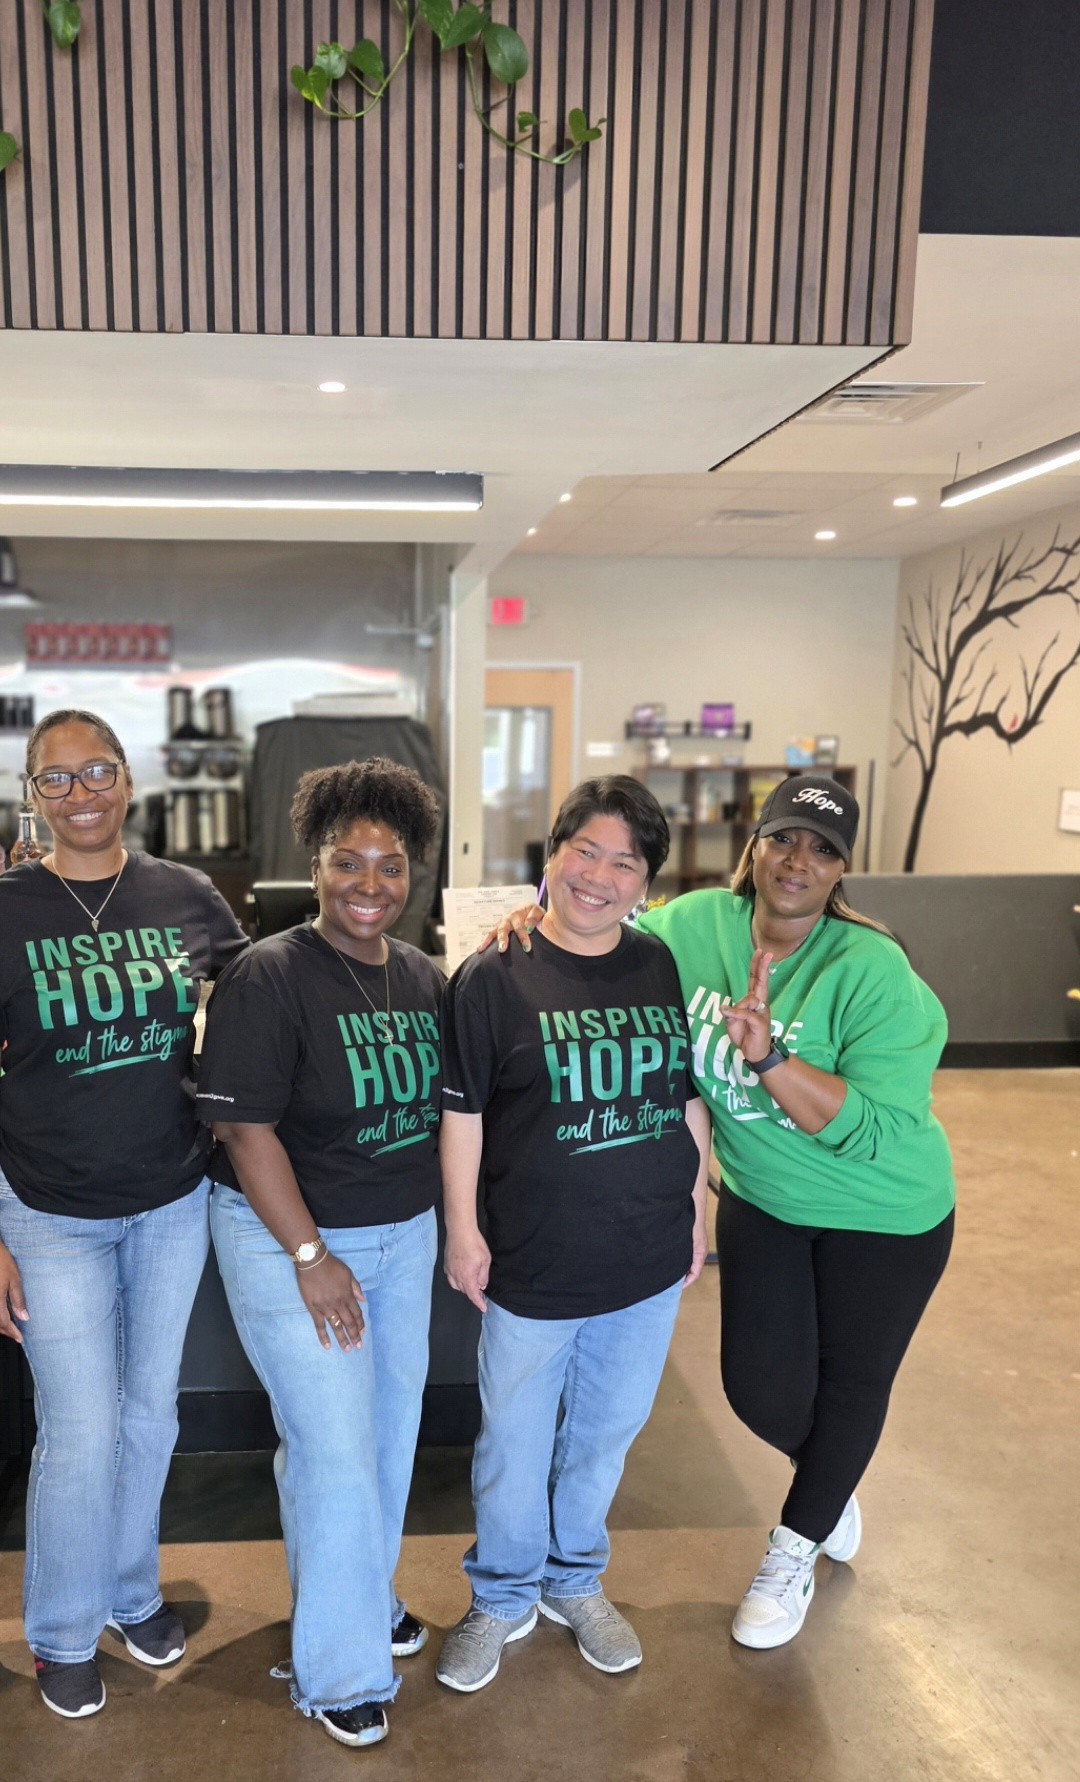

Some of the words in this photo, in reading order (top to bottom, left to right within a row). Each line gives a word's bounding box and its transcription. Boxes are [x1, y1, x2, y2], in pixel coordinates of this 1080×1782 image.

[792, 788, 843, 815] Hope
[25, 927, 189, 971] INSPIRE
[33, 958, 197, 1030] HOPE
[336, 1011, 439, 1046] INSPIR
[538, 1006, 687, 1042] INSPIRE
[56, 1030, 92, 1064] end
[97, 1025, 133, 1060] the
[345, 1042, 439, 1108] HOP
[357, 1109, 389, 1144] end
[393, 1106, 418, 1138] the
[556, 1108, 594, 1142] end
[599, 1104, 632, 1139] the
